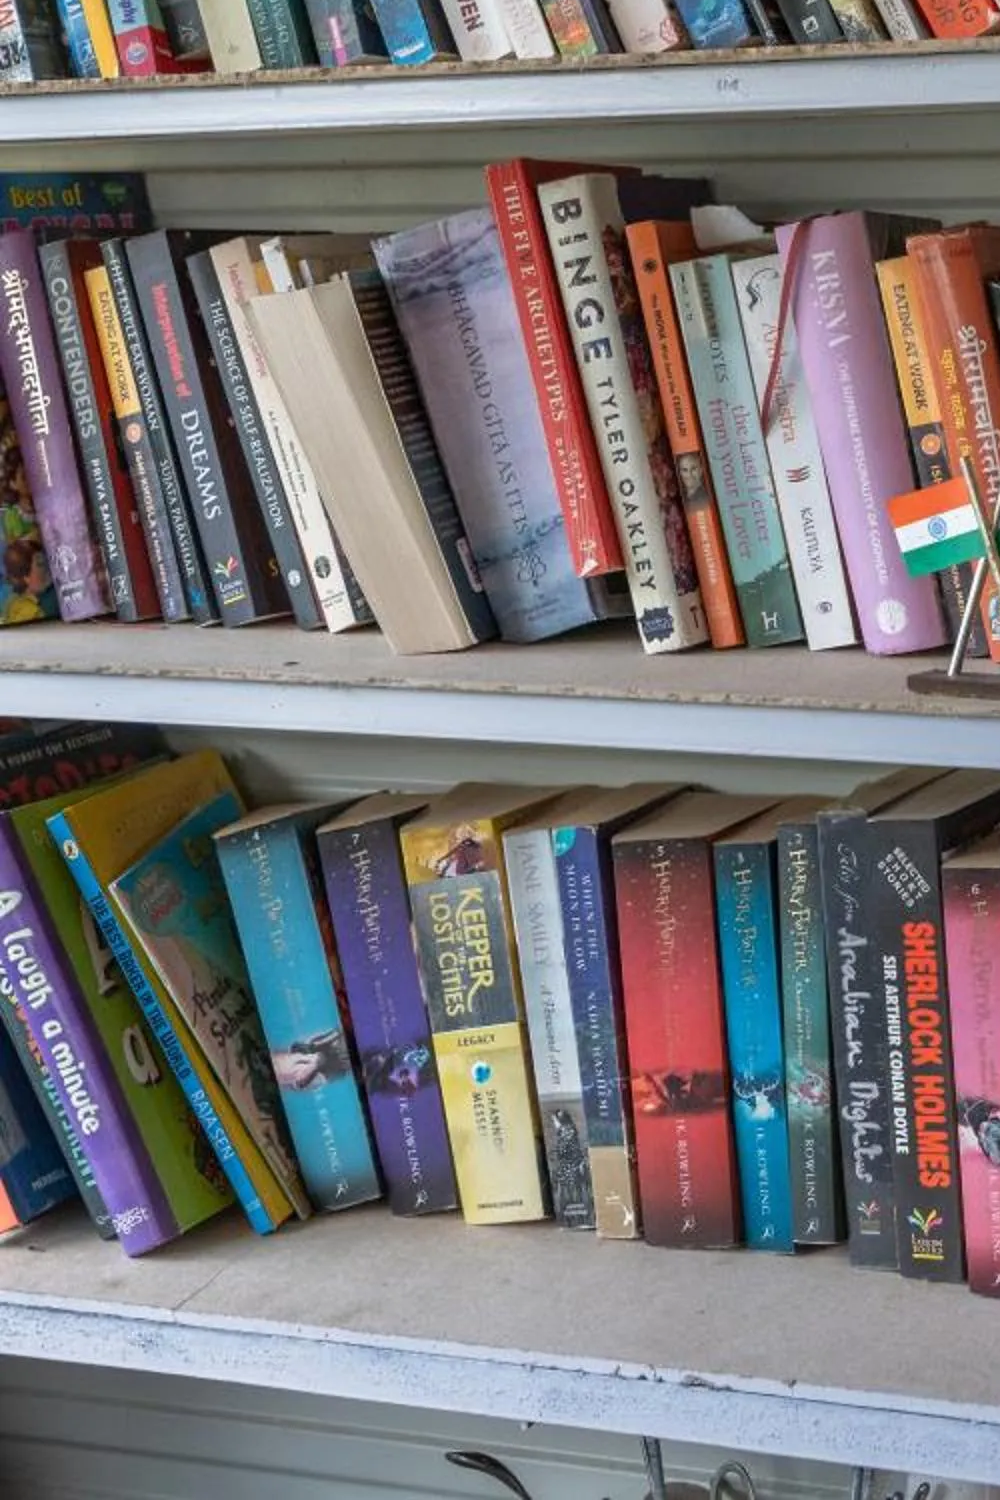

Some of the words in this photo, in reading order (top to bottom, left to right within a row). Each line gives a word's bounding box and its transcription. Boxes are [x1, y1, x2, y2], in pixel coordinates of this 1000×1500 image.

[9, 187, 55, 208] Best
[50, 277, 97, 440] CONTENDERS
[448, 286, 492, 400] BHAGAVAD
[523, 287, 568, 422] ARCHETYPES
[550, 197, 614, 364] BINGE
[597, 375, 630, 466] TYLER
[619, 478, 658, 593] OAKLEY
[180, 409, 224, 522] DREAMS
[427, 891, 455, 947] LOST
[455, 886, 493, 1011] KEEPER
[2, 927, 48, 1009] laugh
[50, 1046, 100, 1135] minute
[456, 1035, 496, 1048] LEGACY
[902, 921, 942, 1066] SHERLOCK
[884, 987, 903, 1055] ARTHUR
[896, 1102, 909, 1155] DOYLE
[912, 1074, 951, 1190] HOLMES
